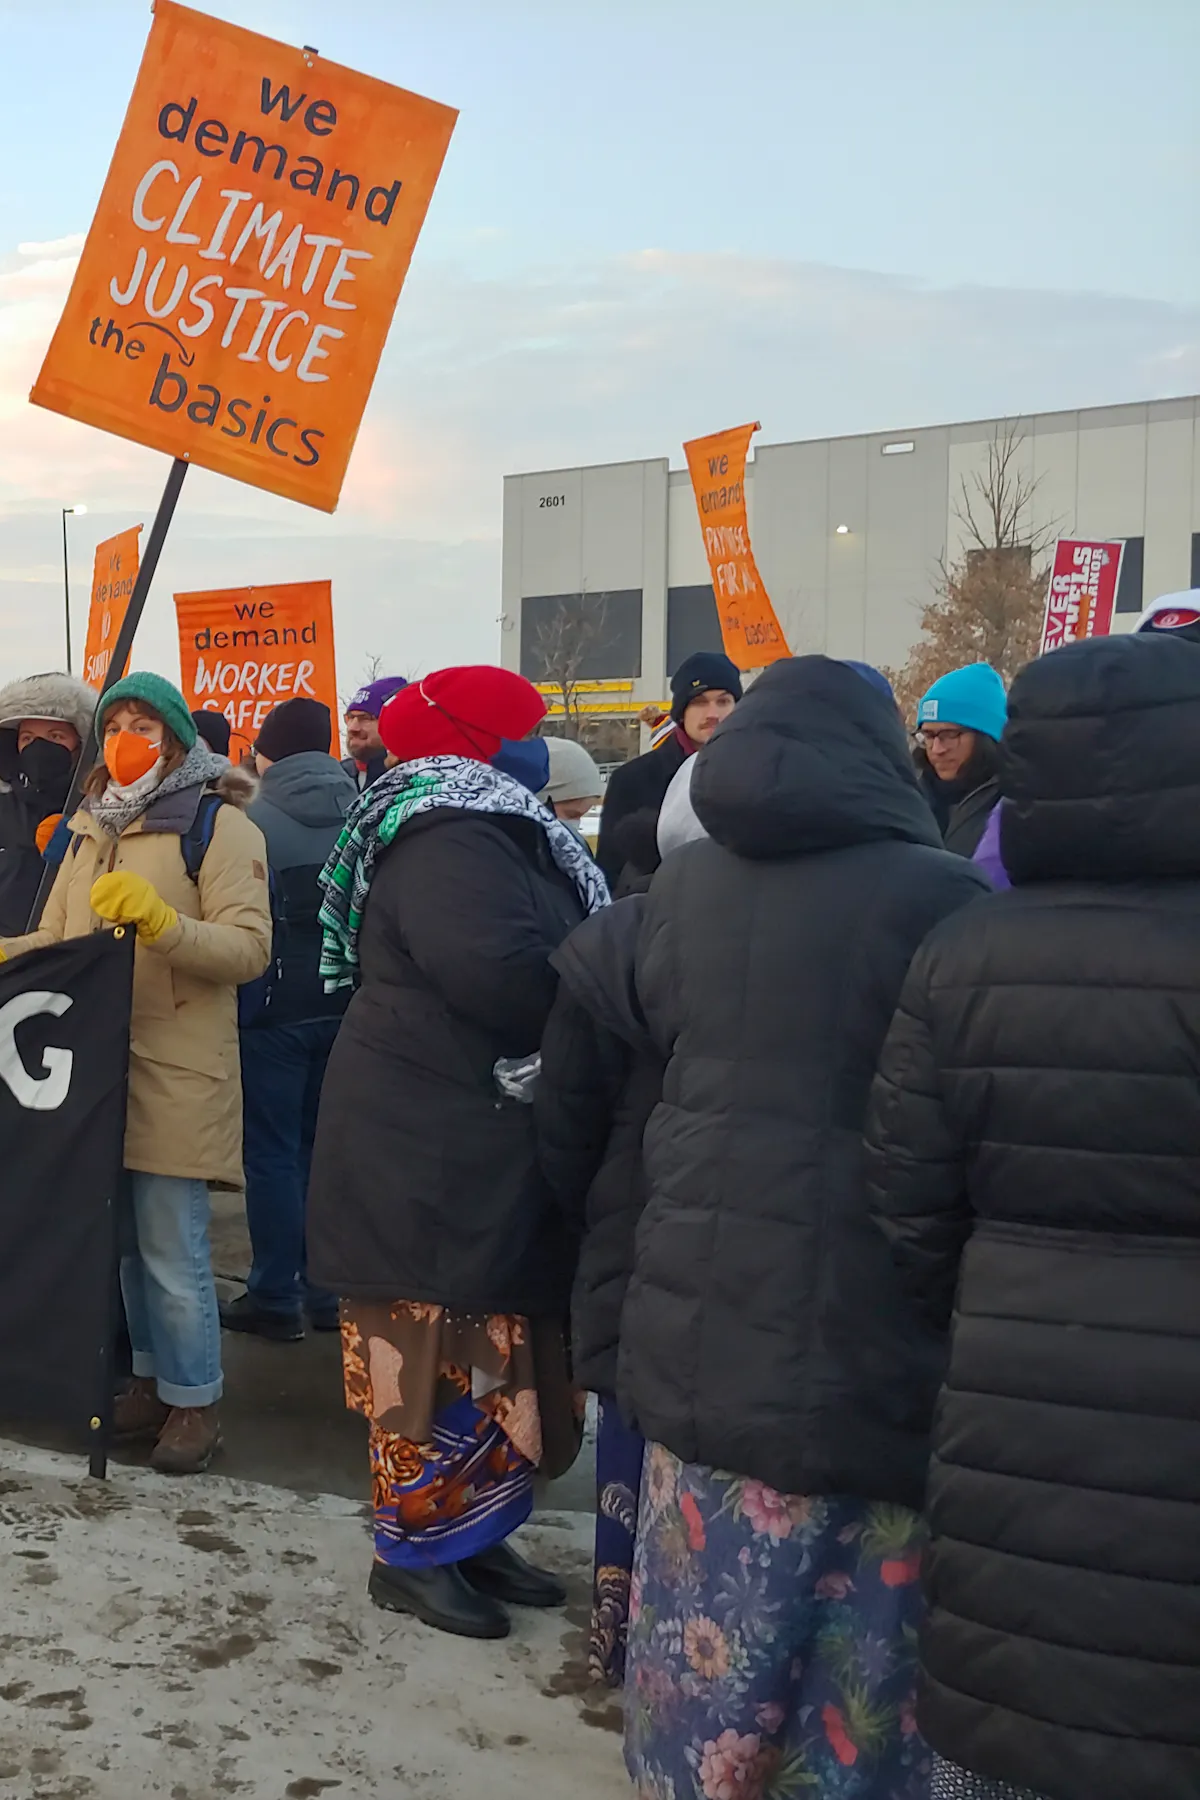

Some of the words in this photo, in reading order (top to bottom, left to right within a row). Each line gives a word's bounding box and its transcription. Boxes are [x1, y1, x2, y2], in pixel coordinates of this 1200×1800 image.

[261, 77, 337, 135] we
[158, 97, 402, 225] demand
[132, 160, 373, 310] CLIMATE
[89, 317, 145, 360] the
[110, 248, 346, 383] JUSTICE
[149, 352, 325, 466] basics
[539, 495, 566, 508] 2601
[234, 601, 275, 620] we
[194, 621, 317, 651] demand
[193, 656, 316, 696] WORKER
